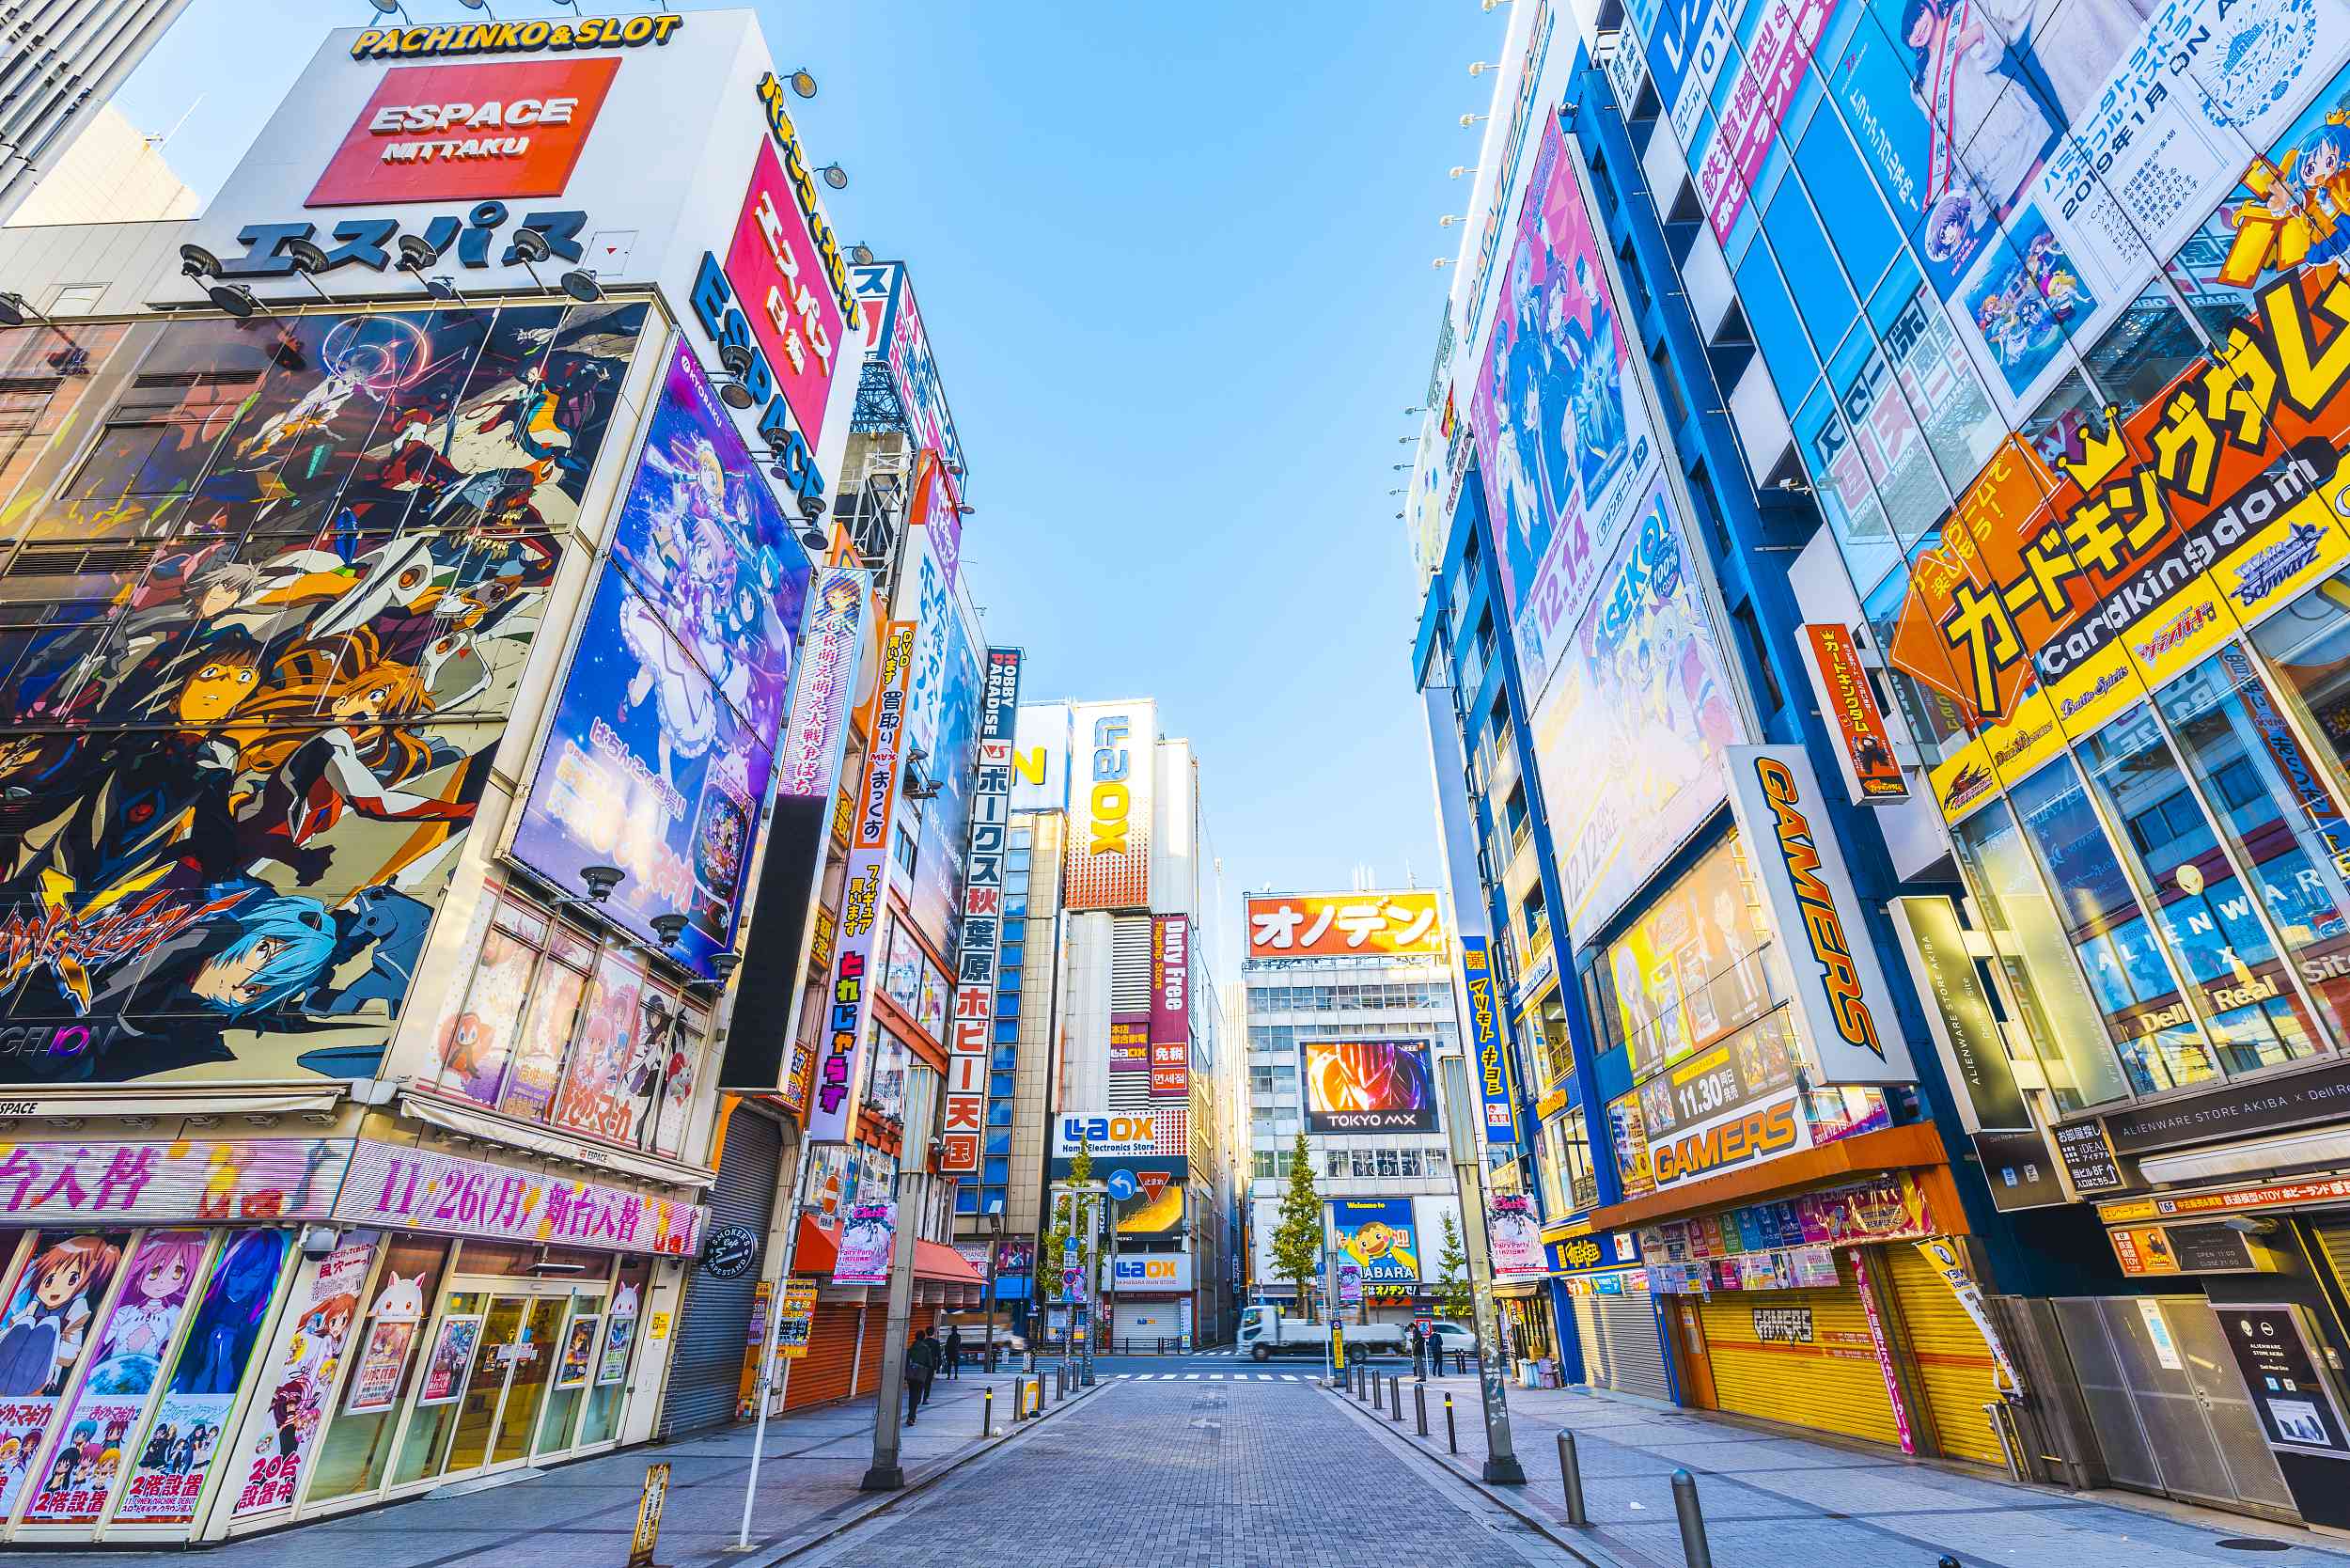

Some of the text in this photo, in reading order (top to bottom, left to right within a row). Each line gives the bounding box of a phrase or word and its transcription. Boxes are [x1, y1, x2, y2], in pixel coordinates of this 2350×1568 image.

[351, 14, 682, 62] PACHINKO&SLOT
[368, 97, 579, 133] ESPACE
[381, 135, 529, 164] NITTAKU
[214, 200, 589, 277] エスパス
[689, 368, 724, 430] KYORAKU
[1538, 511, 1590, 640] 12.14
[2043, 457, 2320, 677] cardkingdom
[883, 632, 902, 685] 買います
[898, 629, 915, 668] DVD
[983, 653, 1005, 736] PARADISE
[1000, 653, 1018, 708] HOBBY
[879, 690, 904, 745] 買取り
[862, 769, 891, 840] まっくす
[844, 877, 866, 938] 買います
[858, 863, 881, 936] フィギュア
[1250, 895, 1436, 949] オノデン
[1754, 756, 1888, 1064] GAMERS
[960, 887, 998, 982] 秋葉原
[1153, 921, 1165, 990] Flagship Store
[1165, 920, 1186, 1011] Duty Free
[1921, 934, 1981, 1087] ALIENWARE STORE AKIBA
[2139, 1002, 2192, 1035] Dell
[2211, 974, 2280, 1012] Real
[1468, 977, 1504, 1096] マツモトキヨシ
[942, 988, 991, 1171] ホビー天国
[1678, 1074, 1724, 1120] 11.30
[1326, 1114, 1418, 1127] TOKYO MX
[1653, 1096, 1800, 1186] GAMERS
[2123, 1114, 2192, 1137] ALIENWARE
[2196, 1105, 2239, 1123] STORE
[2243, 1094, 2289, 1115] AKIBA
[588, 1149, 609, 1163] ESPACE
[1088, 1143, 1131, 1152] Electronics
[1132, 1142, 1155, 1152] Store
[712, 1225, 750, 1247] SMOKER'S
[1346, 1201, 1377, 1210] Welcome
